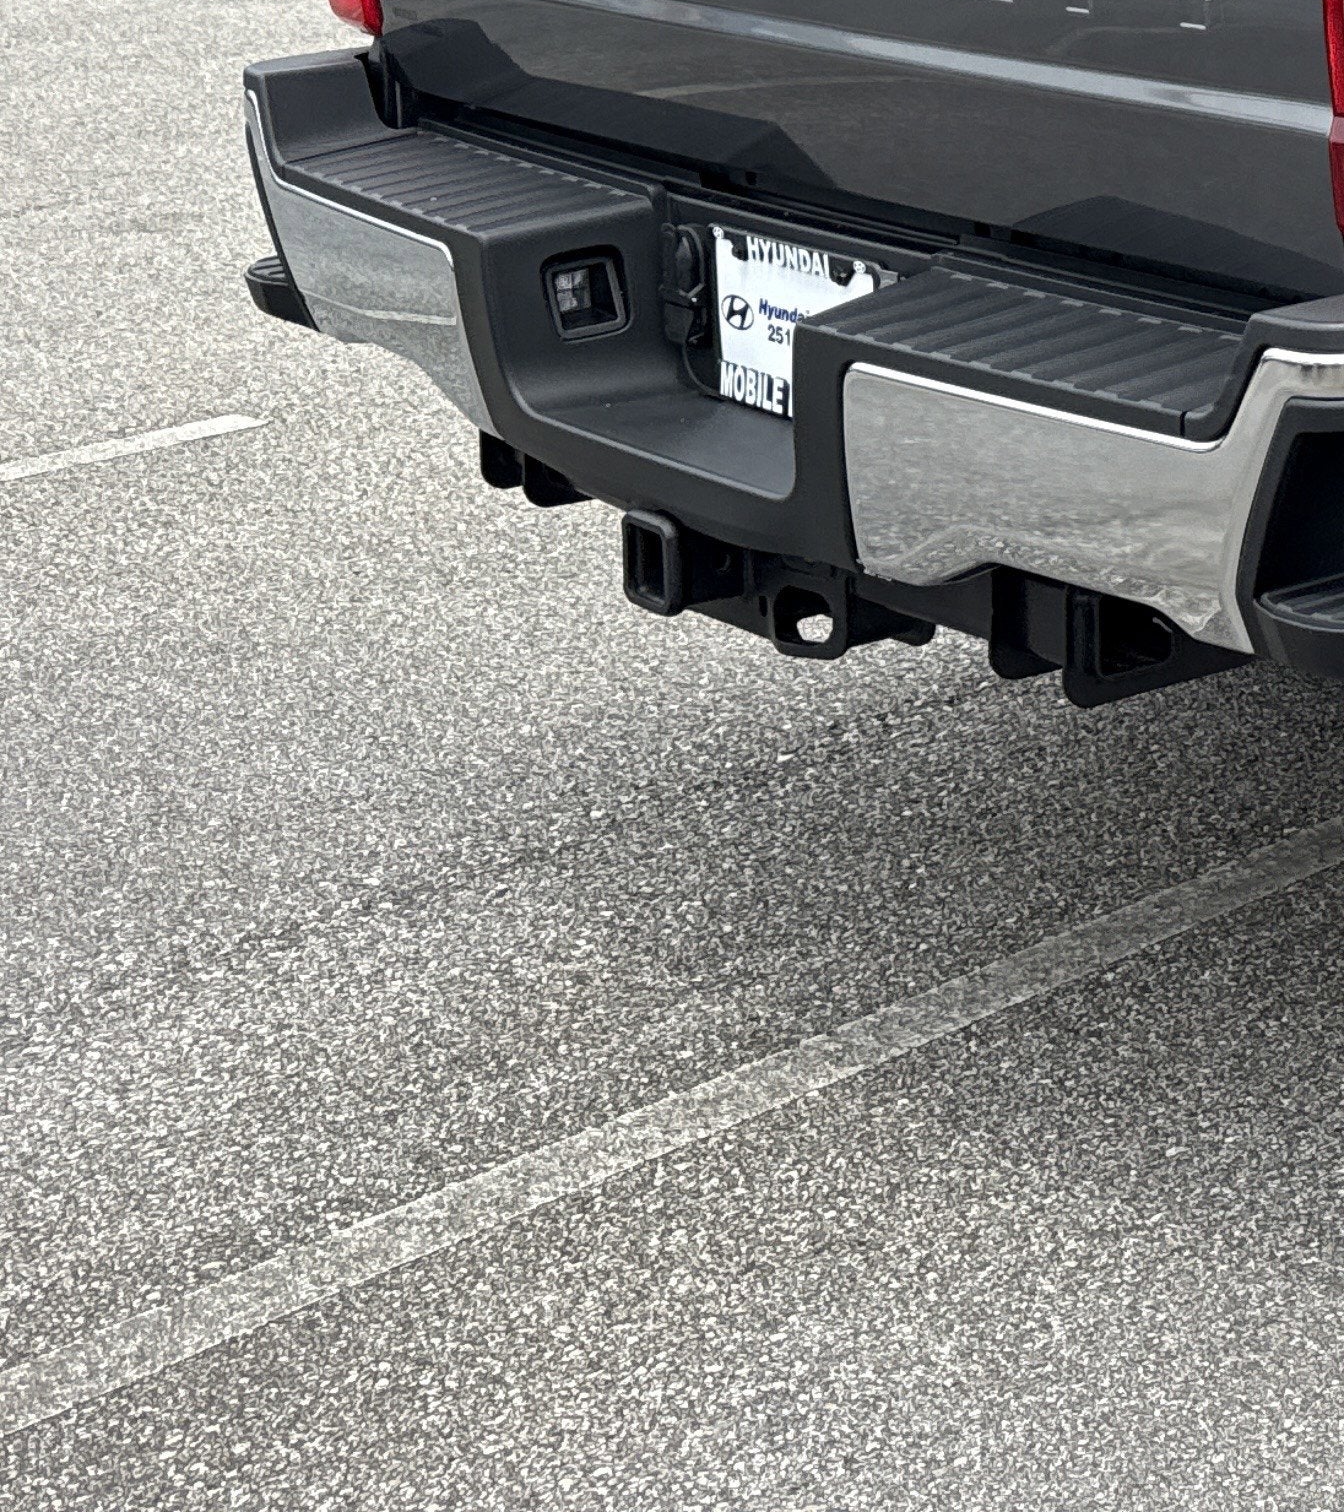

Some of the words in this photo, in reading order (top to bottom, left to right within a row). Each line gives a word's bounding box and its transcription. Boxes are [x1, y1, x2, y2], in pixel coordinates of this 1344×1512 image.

[746, 235, 829, 279] HYUNDAI
[759, 298, 810, 324] Hyunda
[720, 361, 784, 415] MOBILE
